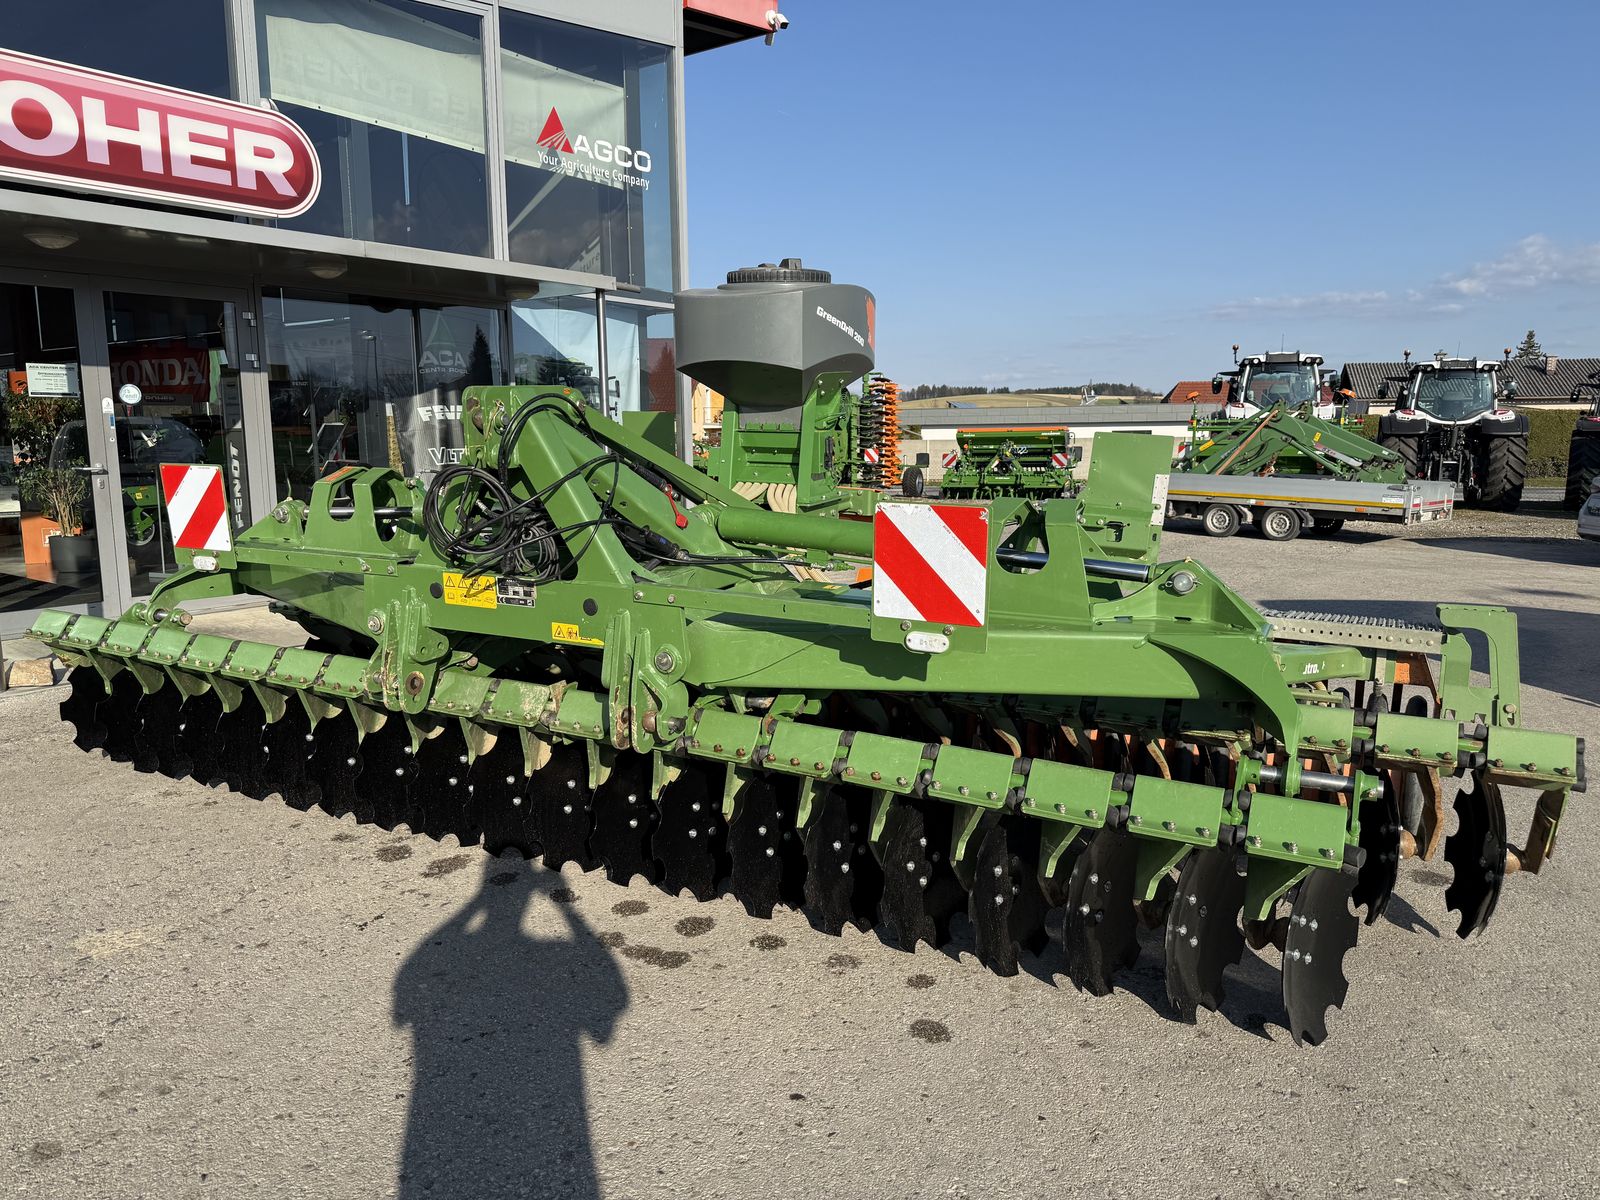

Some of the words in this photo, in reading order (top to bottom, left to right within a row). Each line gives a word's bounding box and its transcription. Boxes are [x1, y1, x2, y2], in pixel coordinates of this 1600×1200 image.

[0, 80, 298, 197] OHER
[574, 135, 651, 172] AGCO
[537, 151, 558, 166] Your
[561, 157, 610, 179] Agriculture
[612, 169, 650, 190] Company
[816, 306, 854, 337] GreenDrill
[419, 350, 467, 368] ACA
[230, 442, 245, 529] FENDT
